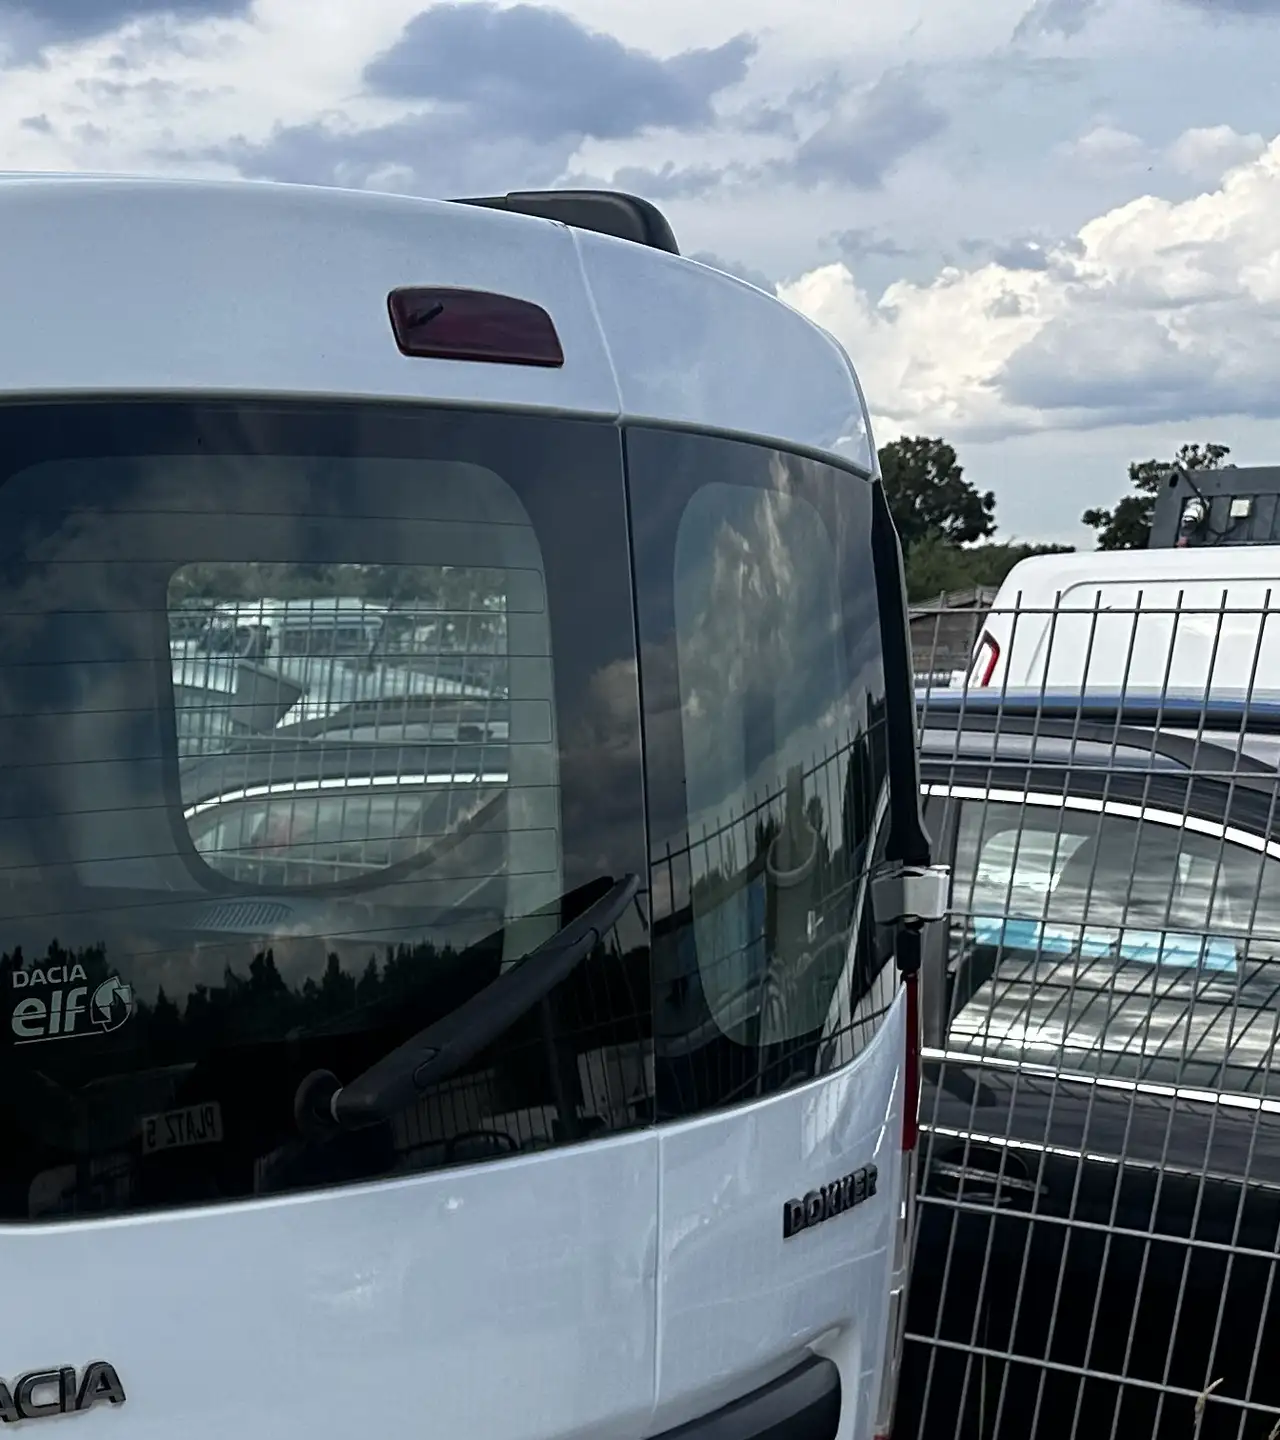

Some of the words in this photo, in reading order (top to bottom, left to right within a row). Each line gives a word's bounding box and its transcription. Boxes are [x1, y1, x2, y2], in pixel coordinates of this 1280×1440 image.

[12, 964, 88, 988] DACIA
[11, 986, 88, 1037] elf
[783, 1163, 878, 1239] DOKKER
